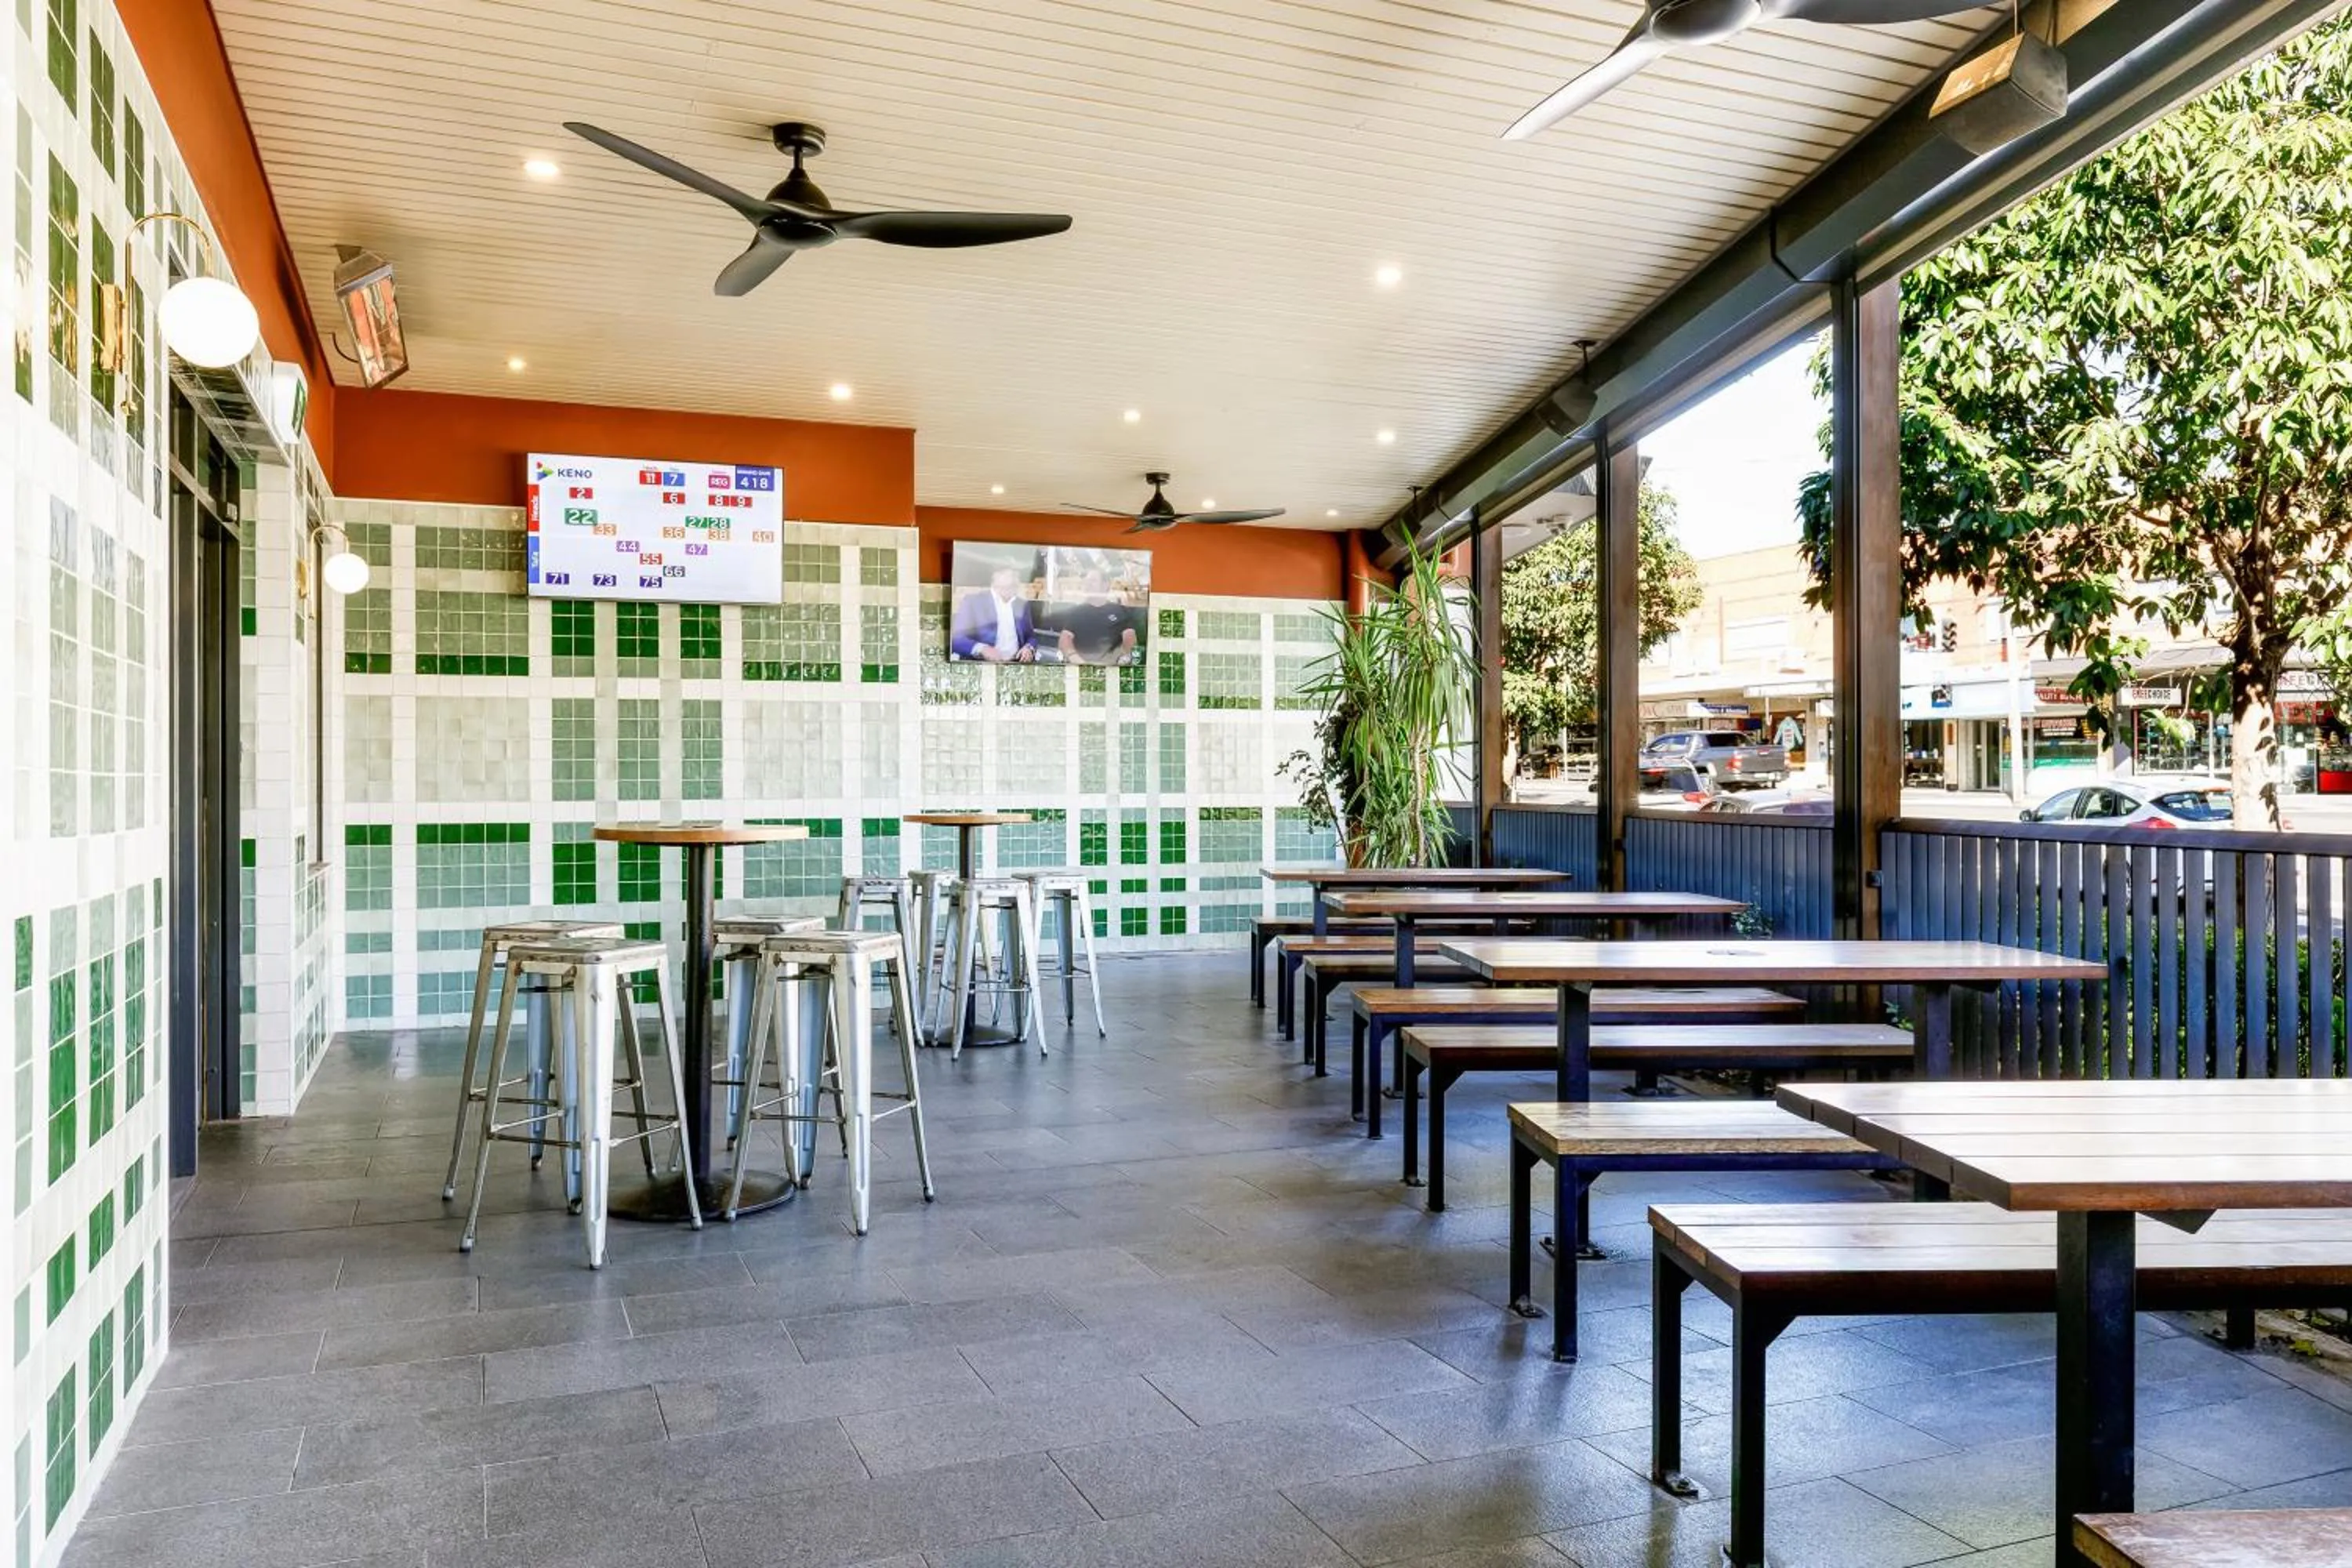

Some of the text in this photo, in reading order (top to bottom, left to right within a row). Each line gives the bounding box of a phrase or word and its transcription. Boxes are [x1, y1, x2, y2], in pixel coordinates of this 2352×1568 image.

[557, 468, 593, 478] KENO
[669, 473, 679, 485] 7
[576, 488, 586, 499] 2
[669, 493, 678, 503] 6
[714, 495, 724, 506] 8
[737, 495, 746, 506] 9
[568, 509, 593, 524] 22
[688, 517, 705, 528] 27
[710, 517, 728, 529] 28
[666, 527, 684, 539] 36
[710, 528, 728, 540] 38
[619, 540, 637, 551] 44
[688, 544, 705, 555] 47
[642, 554, 659, 564] 55
[666, 566, 684, 577] 66
[551, 573, 566, 584] 71
[596, 575, 614, 586] 73
[643, 576, 660, 588] 75
